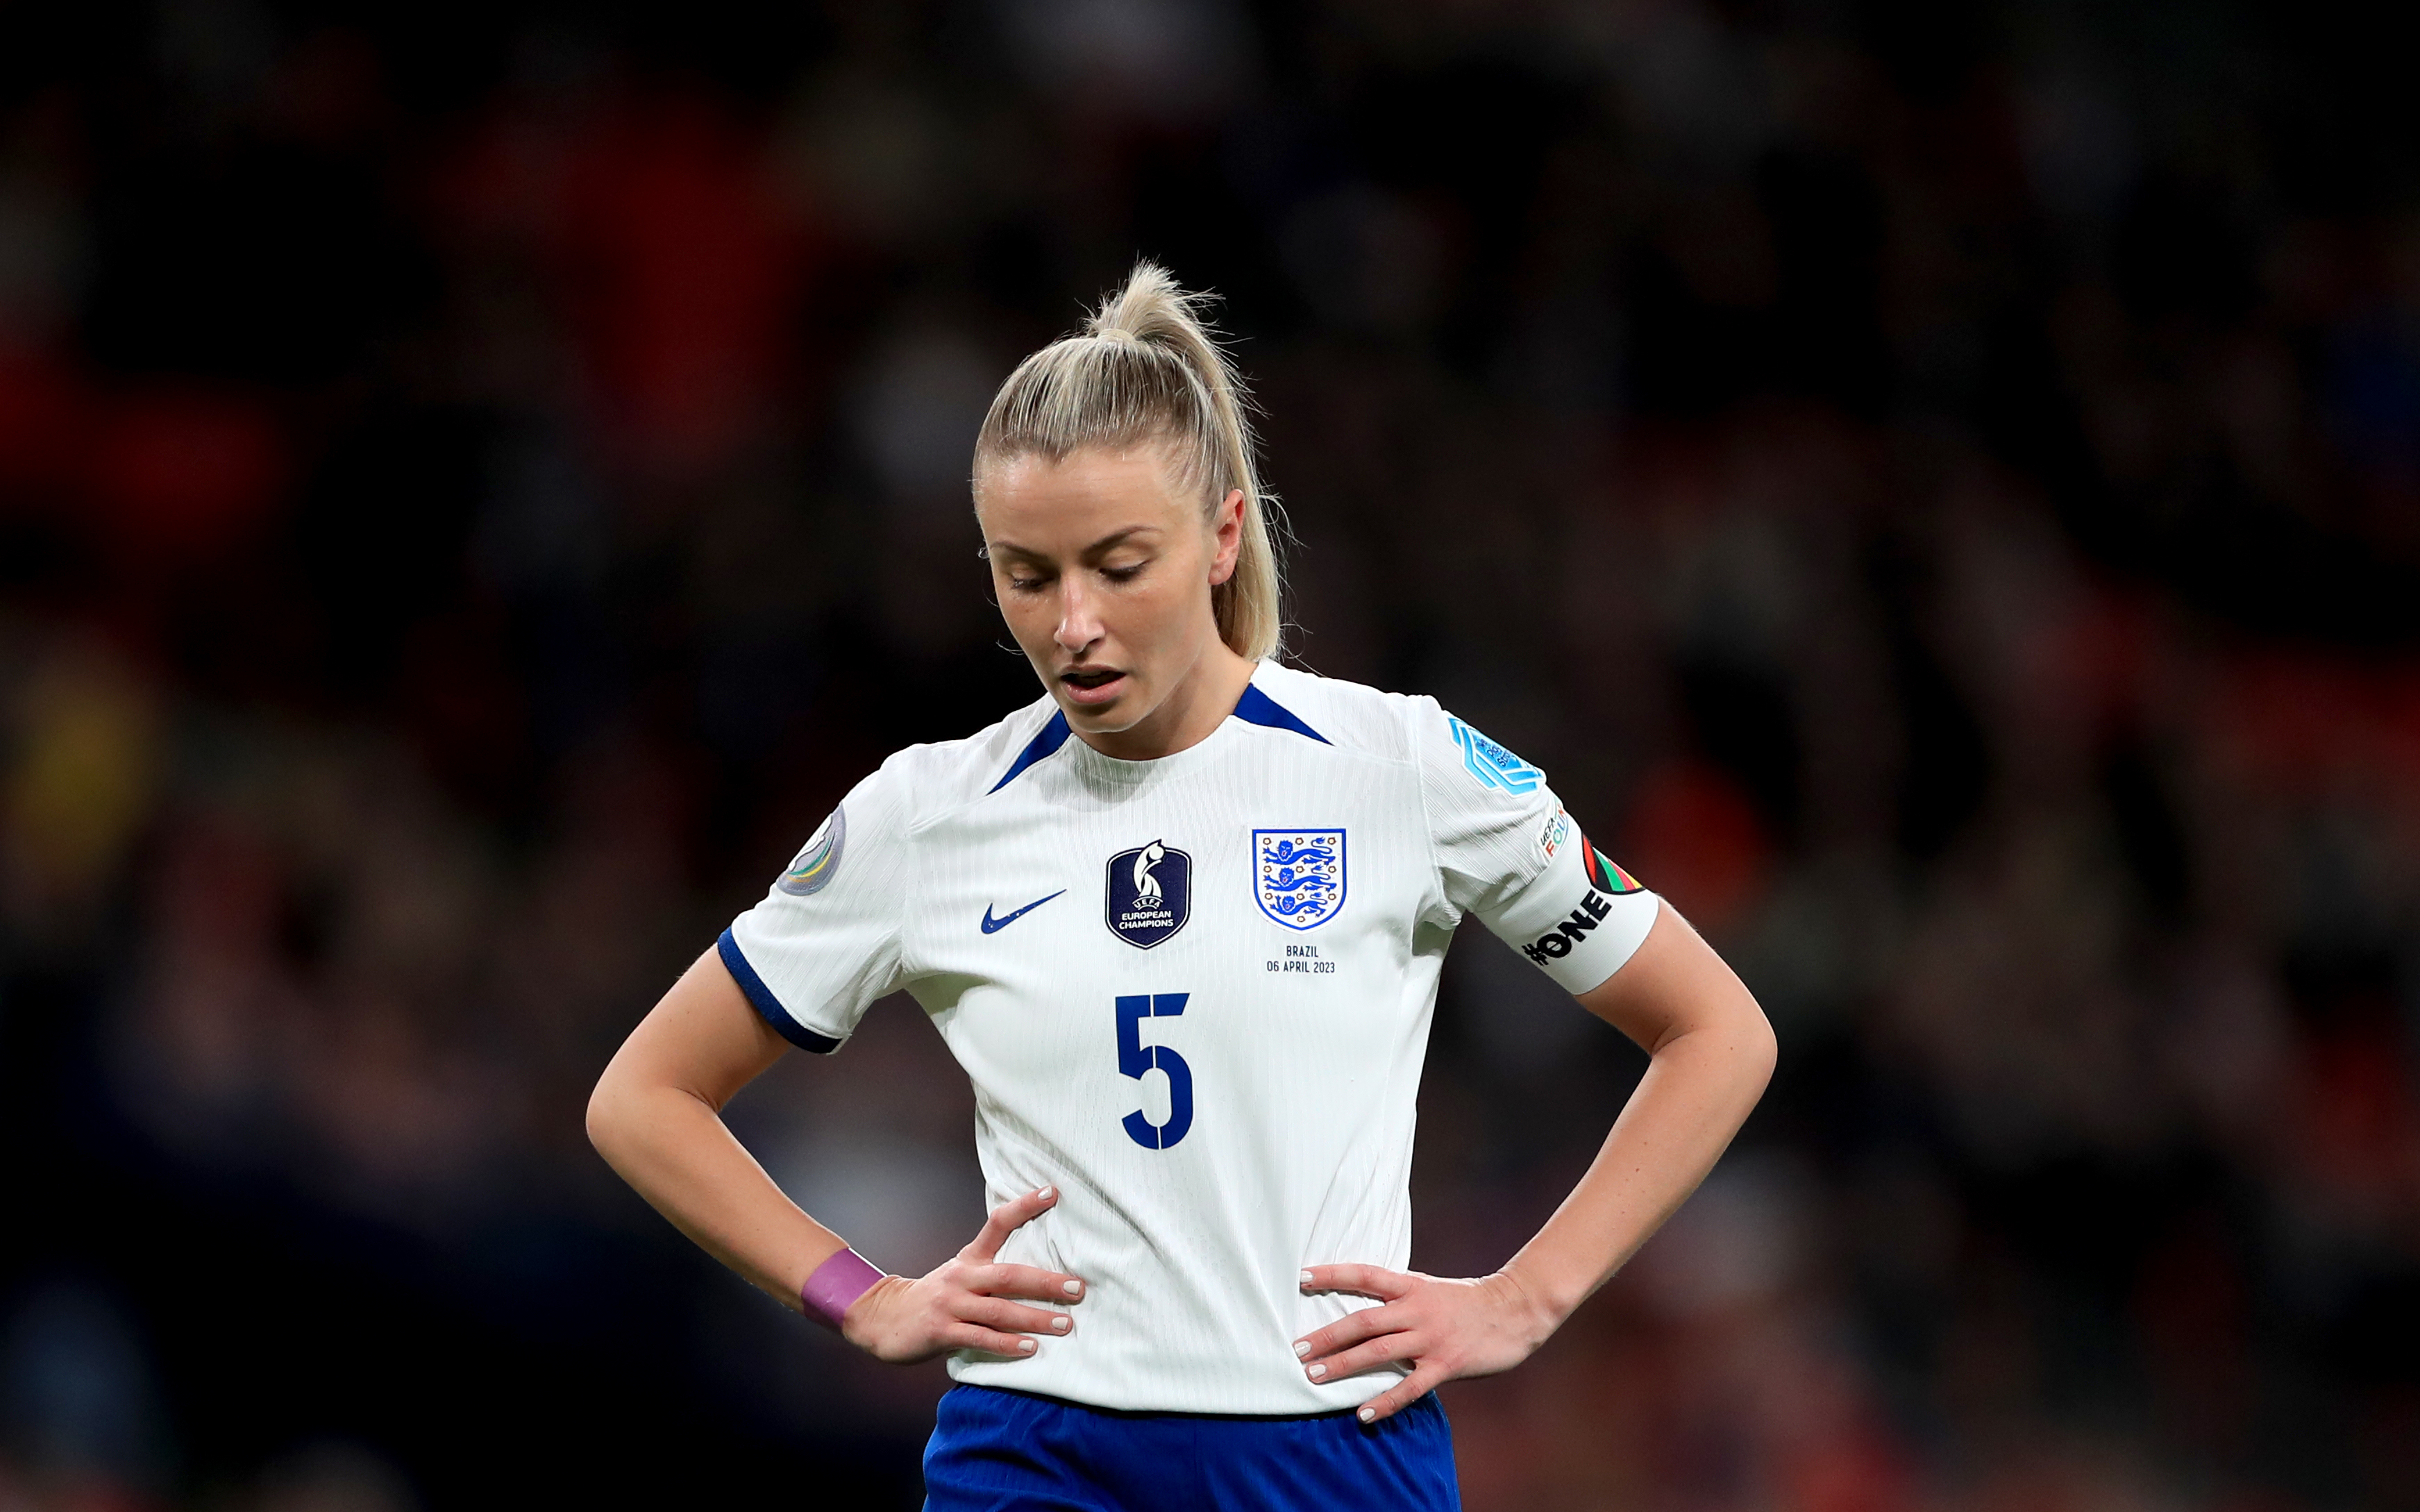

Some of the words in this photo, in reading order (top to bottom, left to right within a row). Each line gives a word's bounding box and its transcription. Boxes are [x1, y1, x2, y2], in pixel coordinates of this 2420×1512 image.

[1540, 817, 1555, 846] UEFA
[1133, 898, 1161, 909] UEFA
[1121, 910, 1172, 921] EUROPEAN
[1118, 918, 1174, 930] CHAMPIONS
[1522, 889, 1613, 966] #ONE
[1286, 945, 1319, 957] BRAZIL
[1266, 960, 1279, 972] 06
[1283, 961, 1310, 973] APRIL
[1313, 961, 1336, 973] 2023
[1115, 992, 1193, 1150] 5
